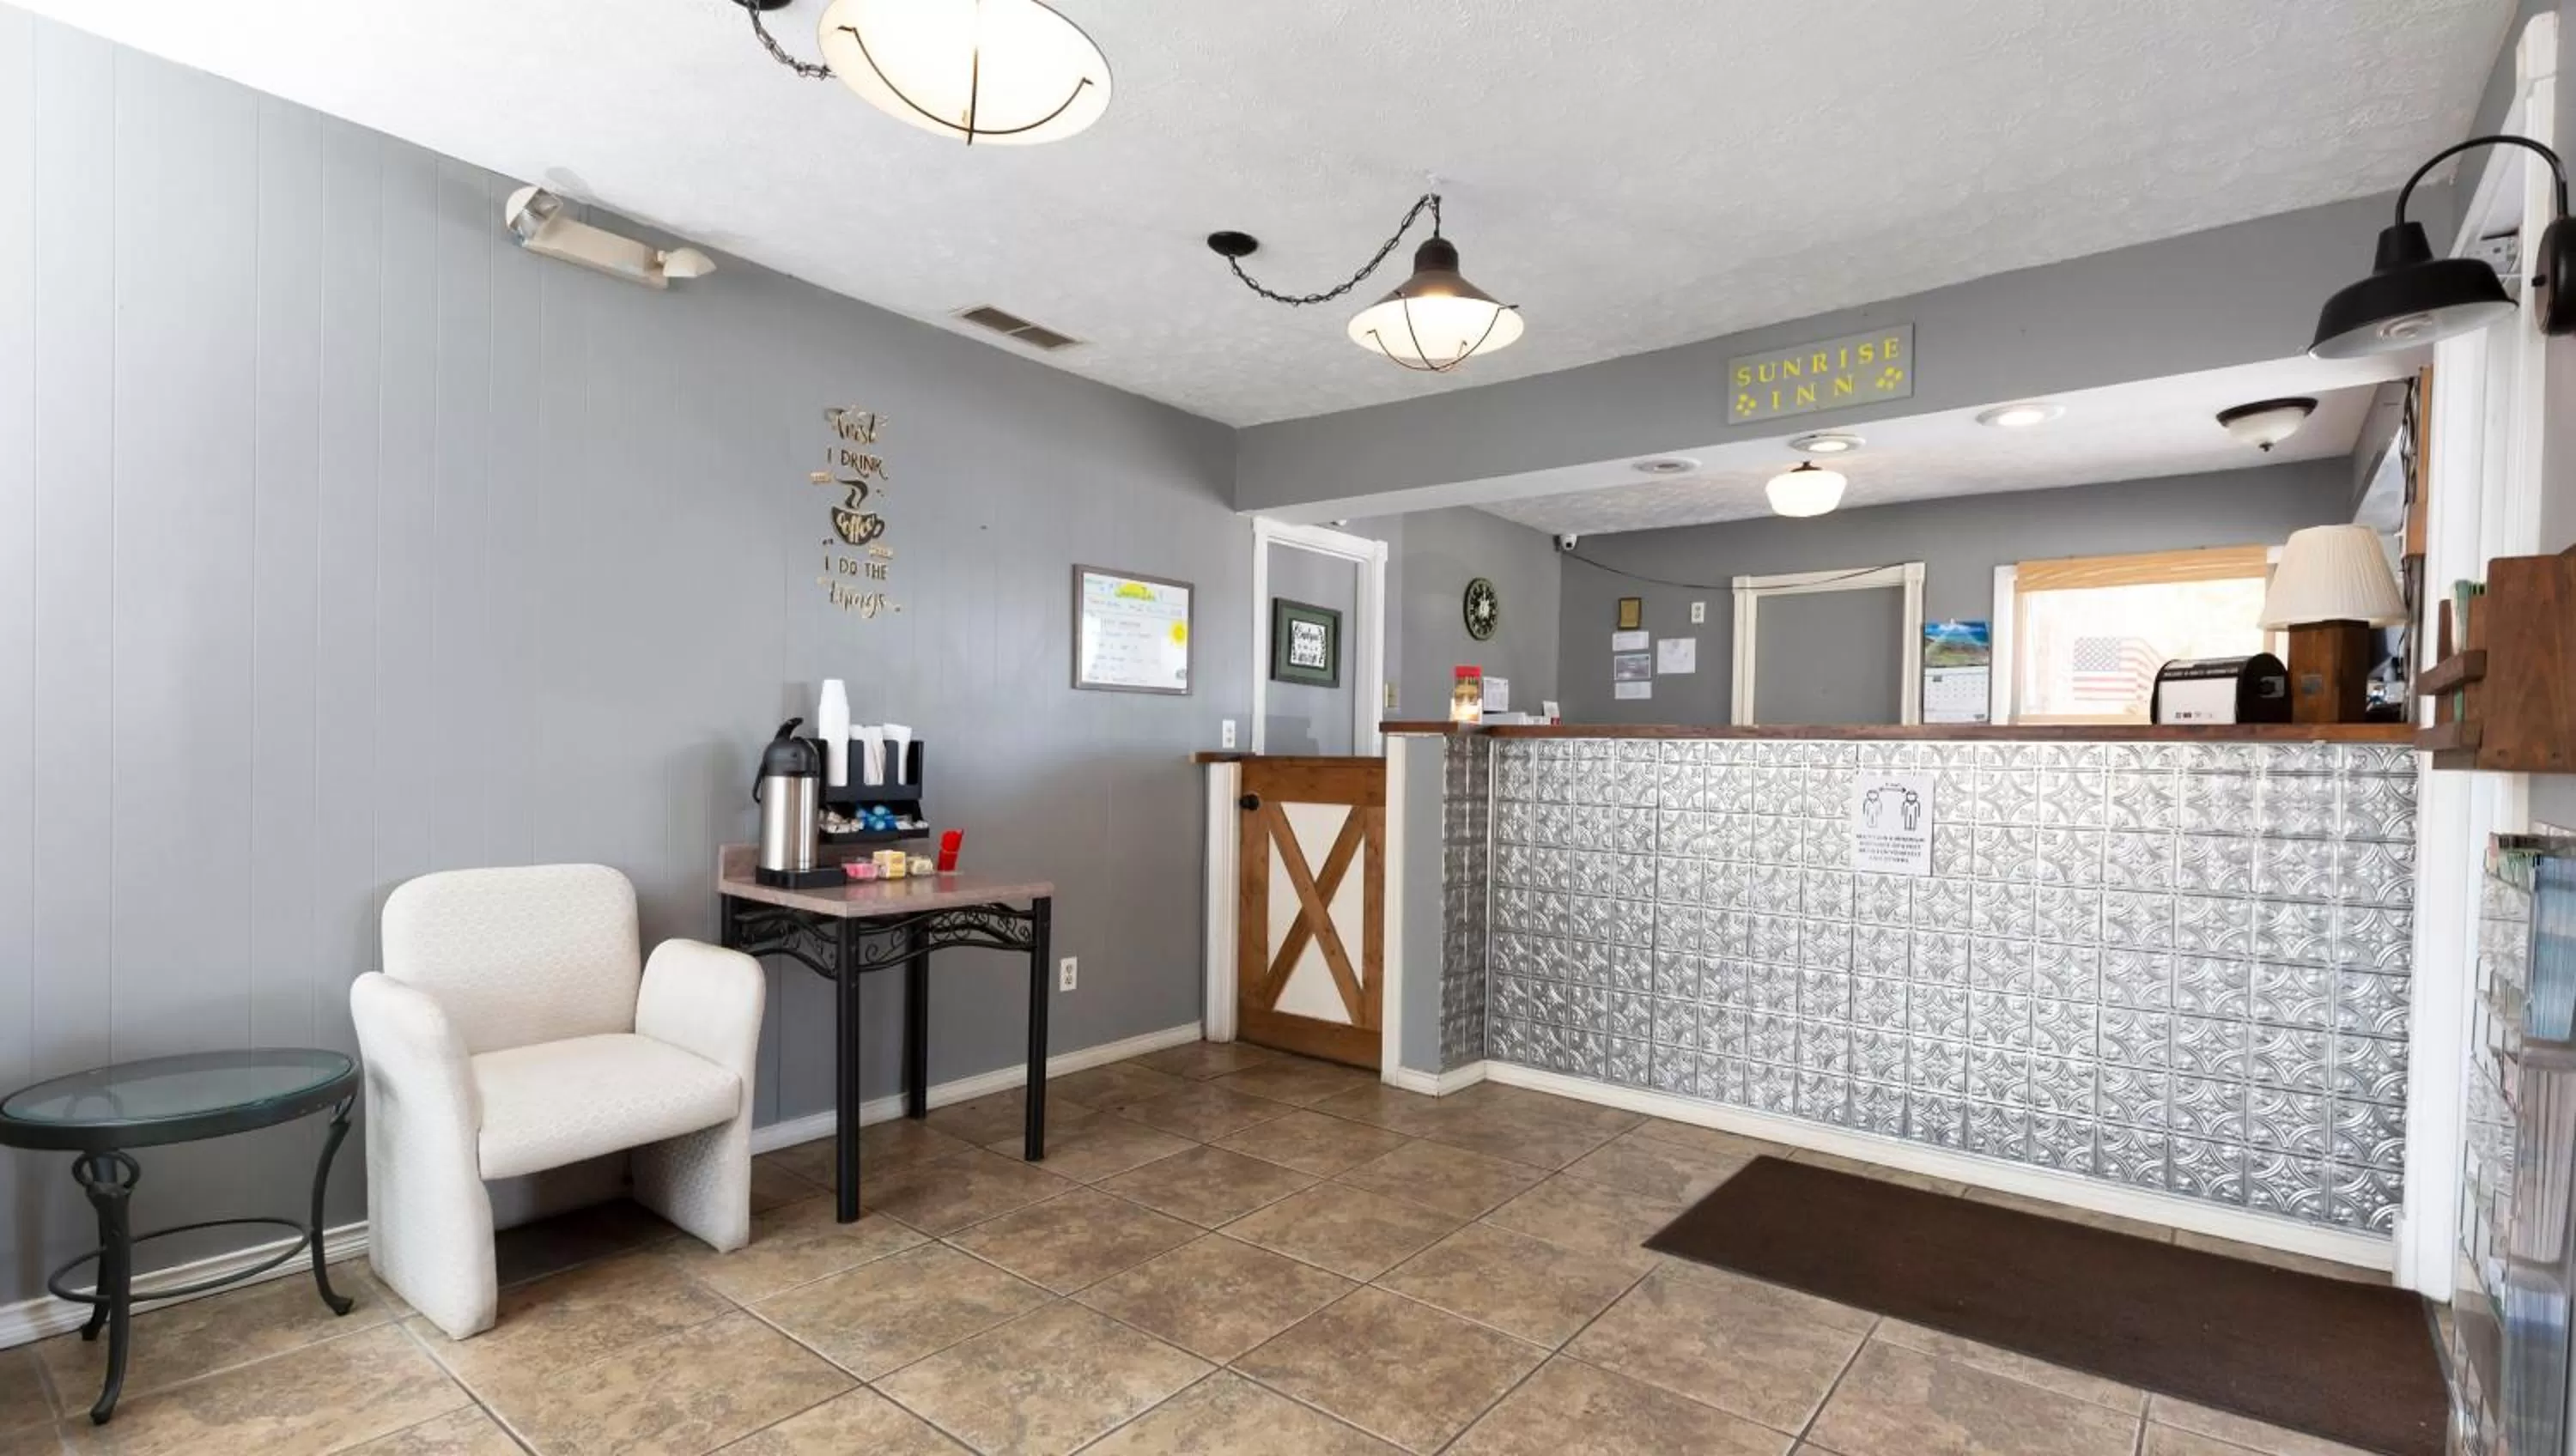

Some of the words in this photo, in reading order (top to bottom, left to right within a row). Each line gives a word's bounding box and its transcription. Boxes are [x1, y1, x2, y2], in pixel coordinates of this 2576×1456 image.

[1736, 338, 1899, 386] SUNRISE
[1771, 374, 1856, 410] INN
[841, 449, 889, 481] DRINK
[839, 557, 858, 575] DO
[865, 562, 887, 580] THE
